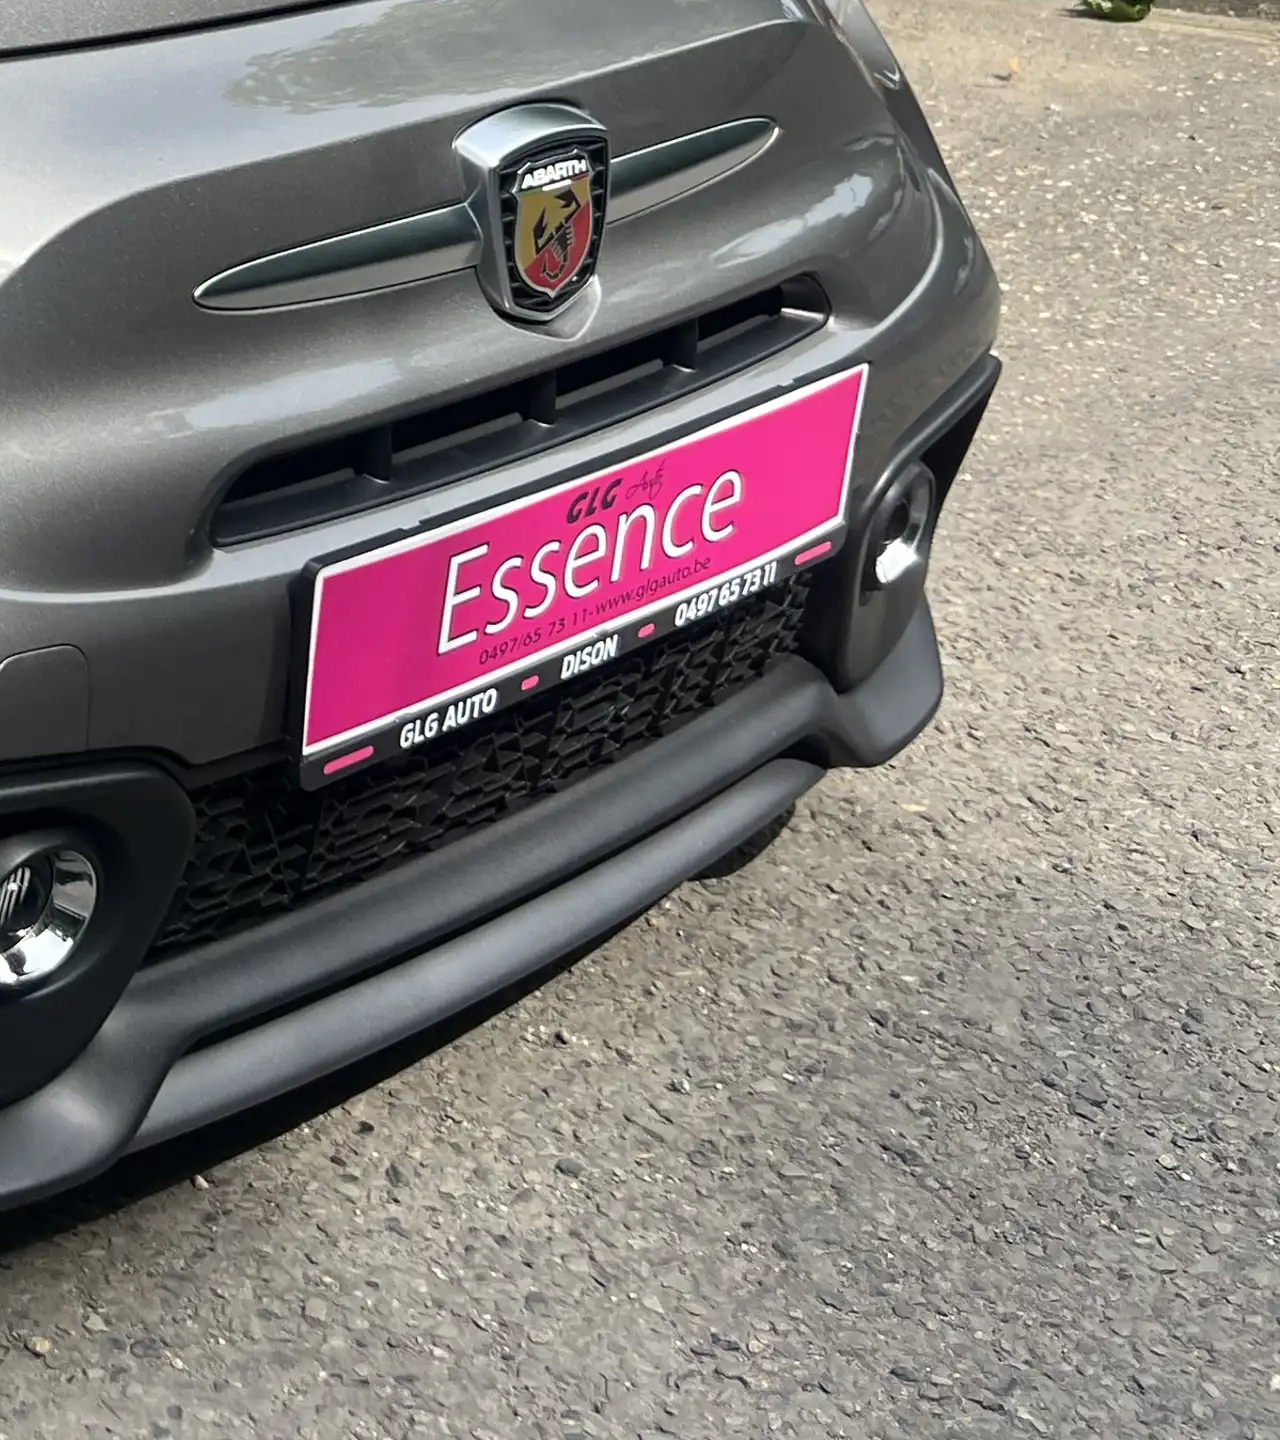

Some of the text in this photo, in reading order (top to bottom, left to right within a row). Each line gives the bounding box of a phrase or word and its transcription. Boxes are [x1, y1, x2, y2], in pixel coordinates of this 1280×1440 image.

[521, 158, 588, 190] ABARTH
[566, 478, 624, 525] GLG
[436, 468, 744, 655] Essence
[548, 616, 568, 637] 73
[400, 712, 439, 749] GLG
[441, 687, 498, 733] AUTO
[560, 634, 619, 680] DISON
